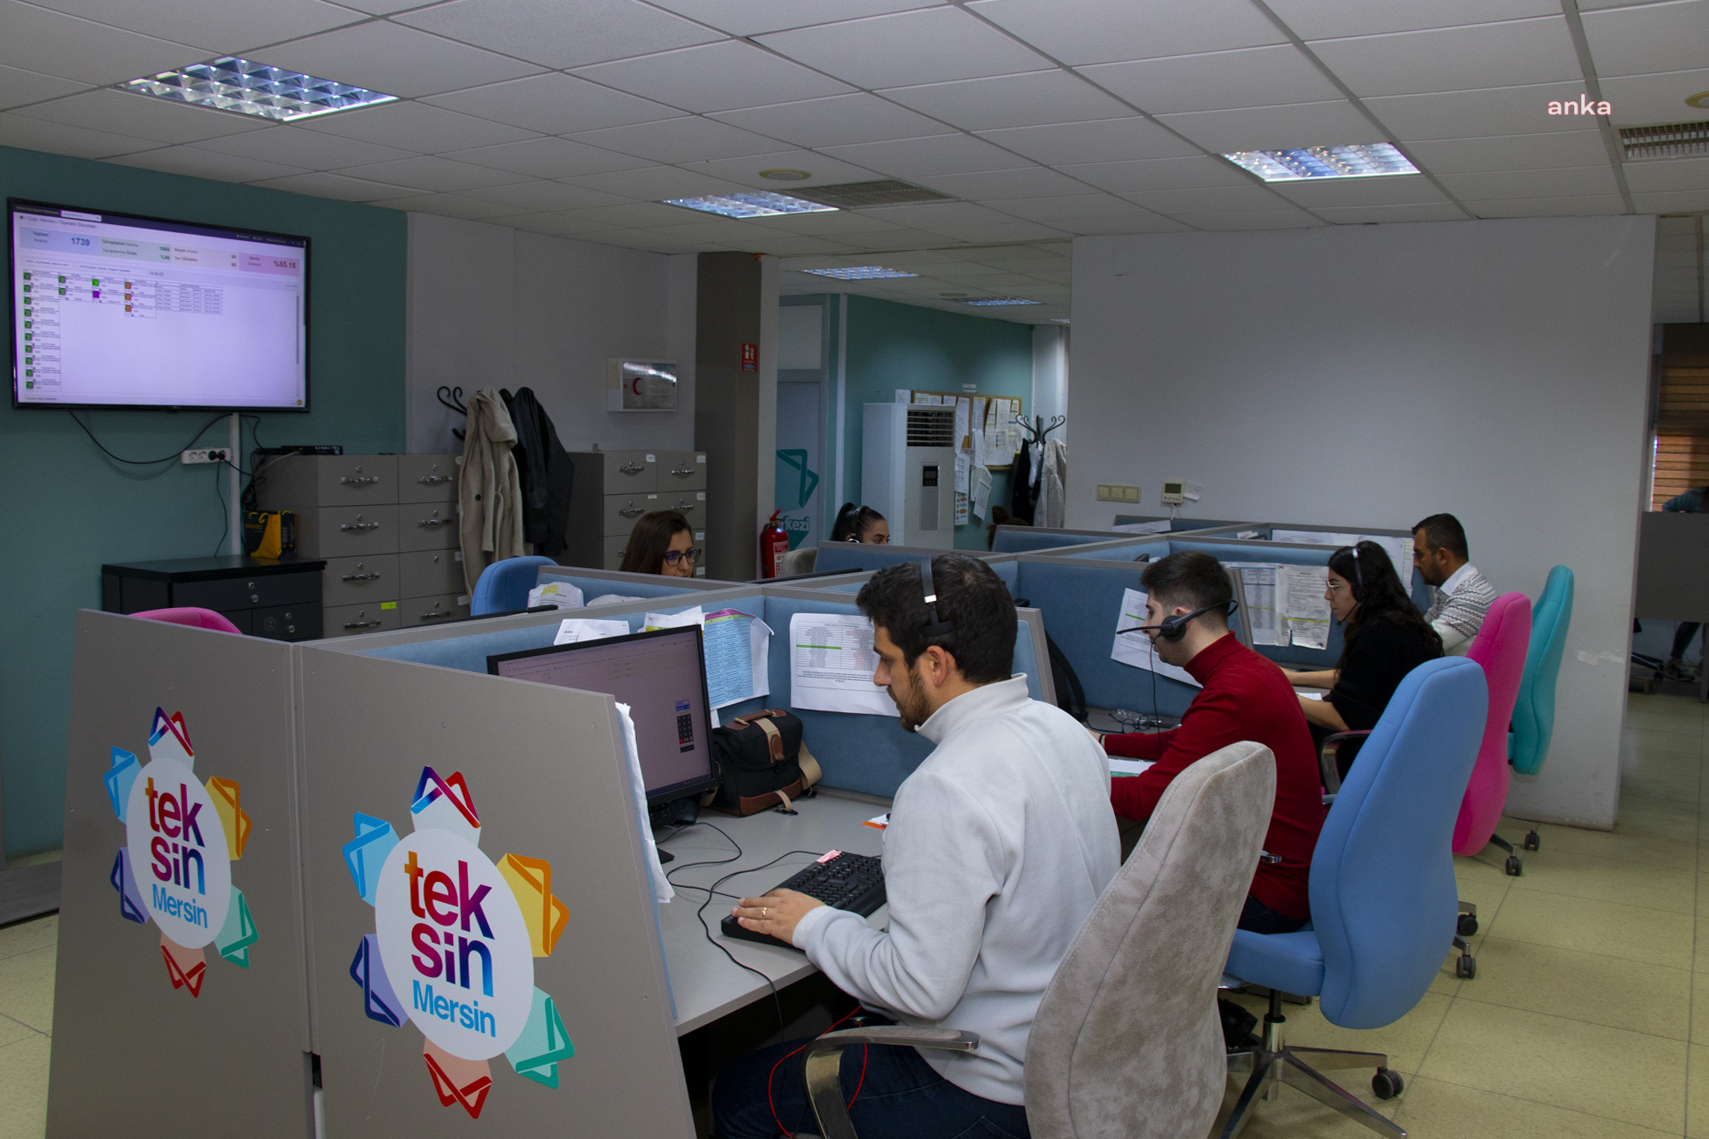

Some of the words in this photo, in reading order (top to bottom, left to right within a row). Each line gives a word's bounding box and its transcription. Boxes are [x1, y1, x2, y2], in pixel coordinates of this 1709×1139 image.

[71, 237, 91, 246] 1739
[273, 259, 297, 269] %85.15
[145, 776, 205, 848] tek
[150, 835, 206, 895] sin
[152, 883, 208, 929] Mersin
[404, 850, 495, 940] tek
[411, 923, 494, 998] sin
[412, 979, 496, 1038] Mersin
